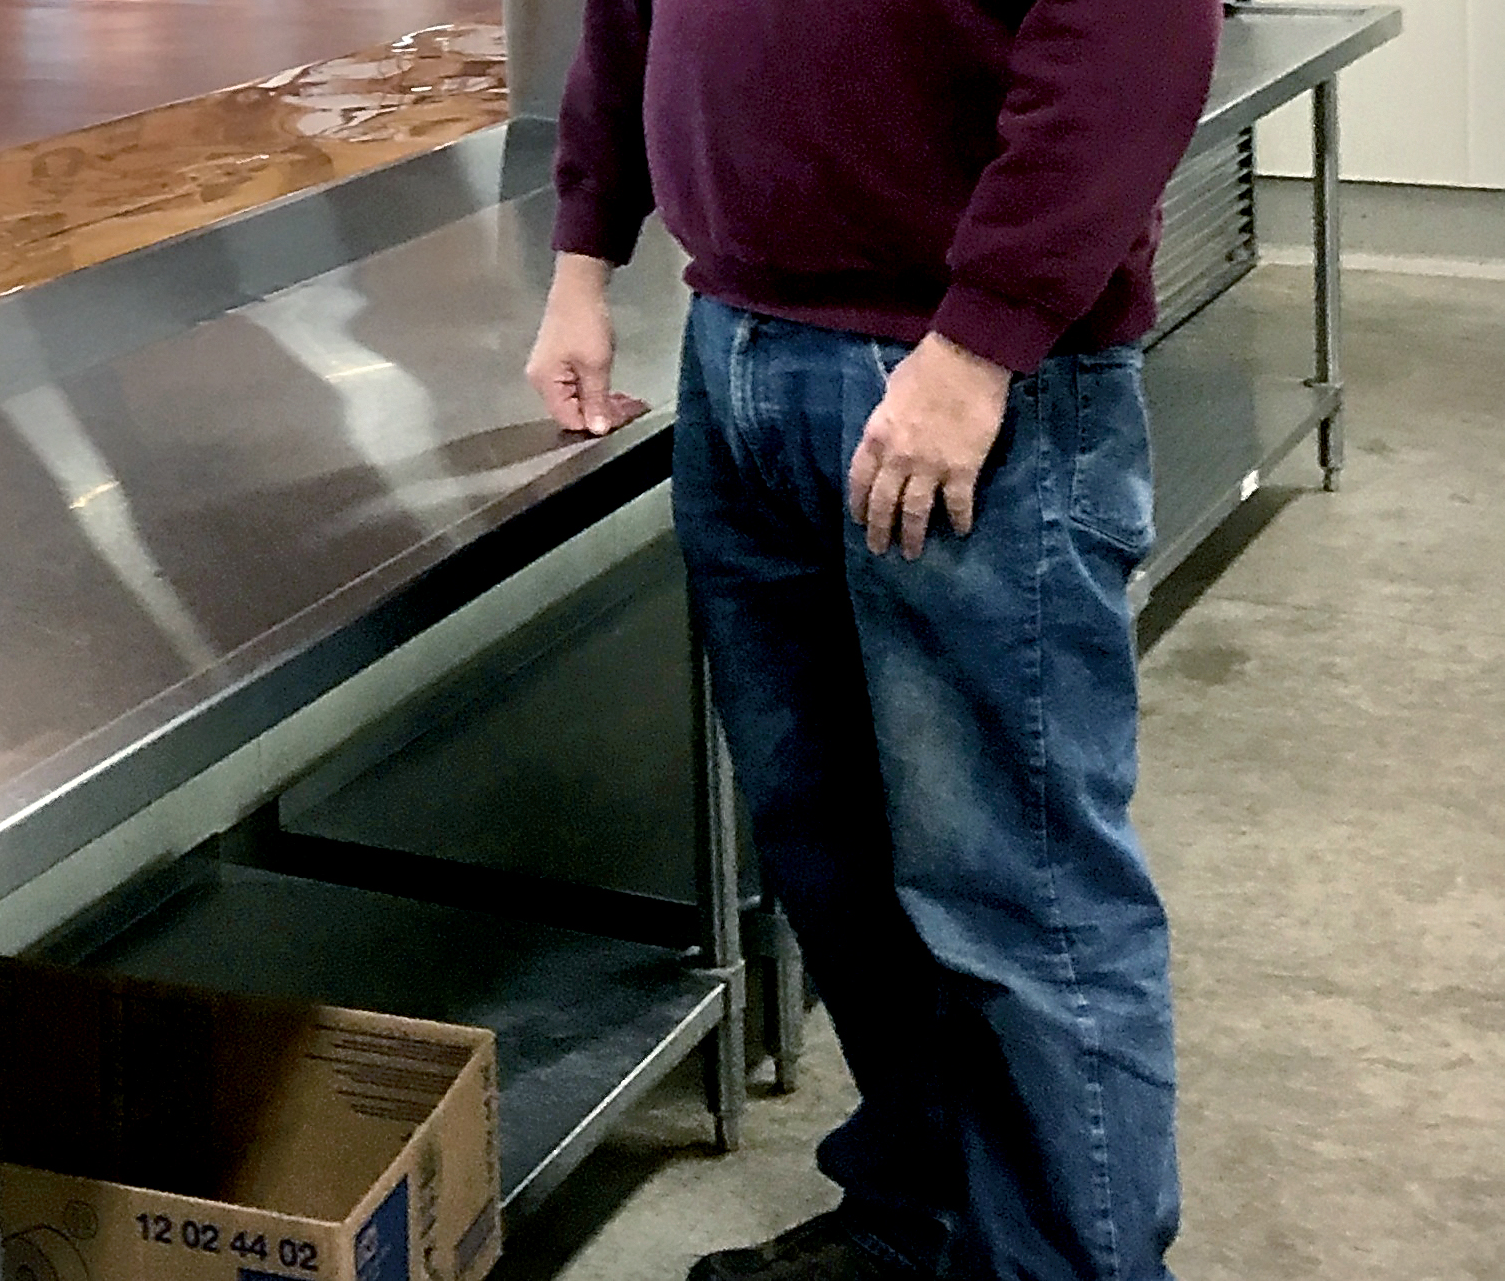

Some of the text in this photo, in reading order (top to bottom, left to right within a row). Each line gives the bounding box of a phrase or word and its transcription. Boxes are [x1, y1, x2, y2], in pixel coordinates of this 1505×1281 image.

[136, 1213, 172, 1244] 12
[182, 1221, 220, 1254] 02
[230, 1231, 267, 1261] 44
[279, 1238, 319, 1271] 02
